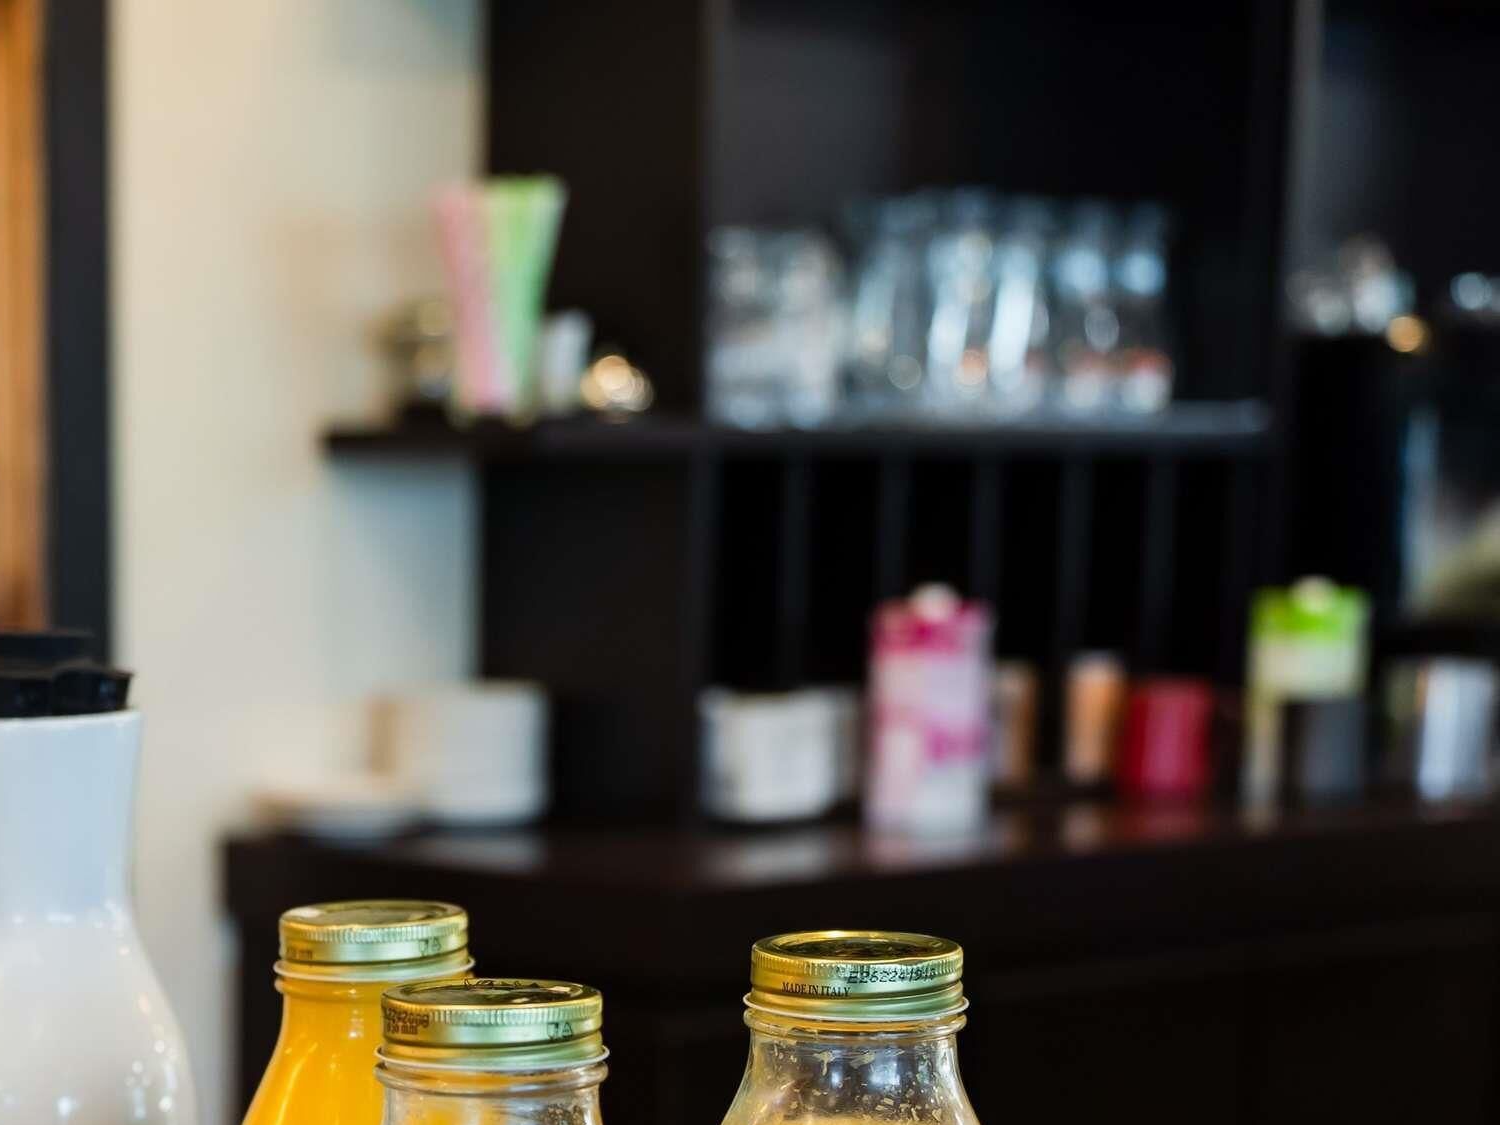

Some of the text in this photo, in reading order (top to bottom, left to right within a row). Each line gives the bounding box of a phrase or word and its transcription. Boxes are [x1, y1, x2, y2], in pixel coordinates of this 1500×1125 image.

[782, 981, 851, 997] MADE IN ITALY
